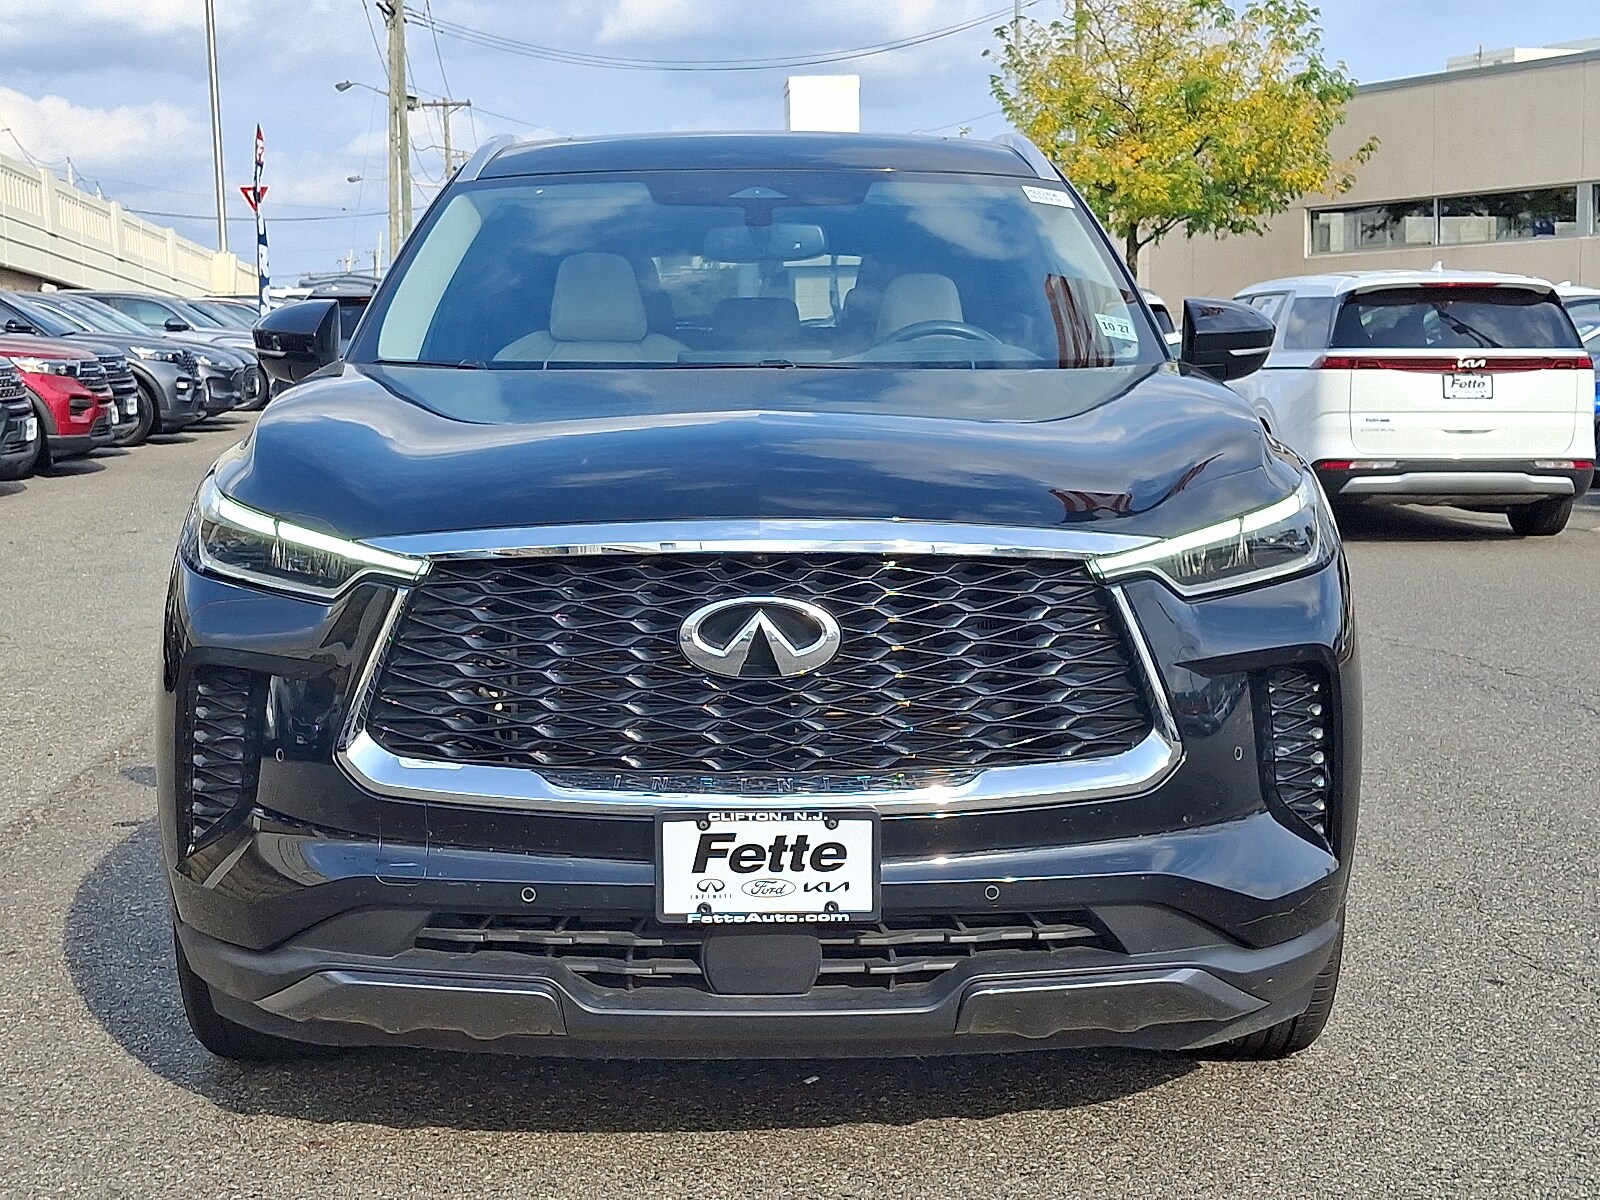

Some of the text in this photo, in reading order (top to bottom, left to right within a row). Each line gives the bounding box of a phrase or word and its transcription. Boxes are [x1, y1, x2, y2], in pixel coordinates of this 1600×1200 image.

[612, 774, 908, 793] INFINITI
[708, 812, 829, 822] CLIFTON, N.J.
[691, 832, 848, 874] Fette
[750, 879, 786, 896] Ford
[803, 881, 850, 893] KIA
[686, 911, 850, 924] FetteAuto.com
